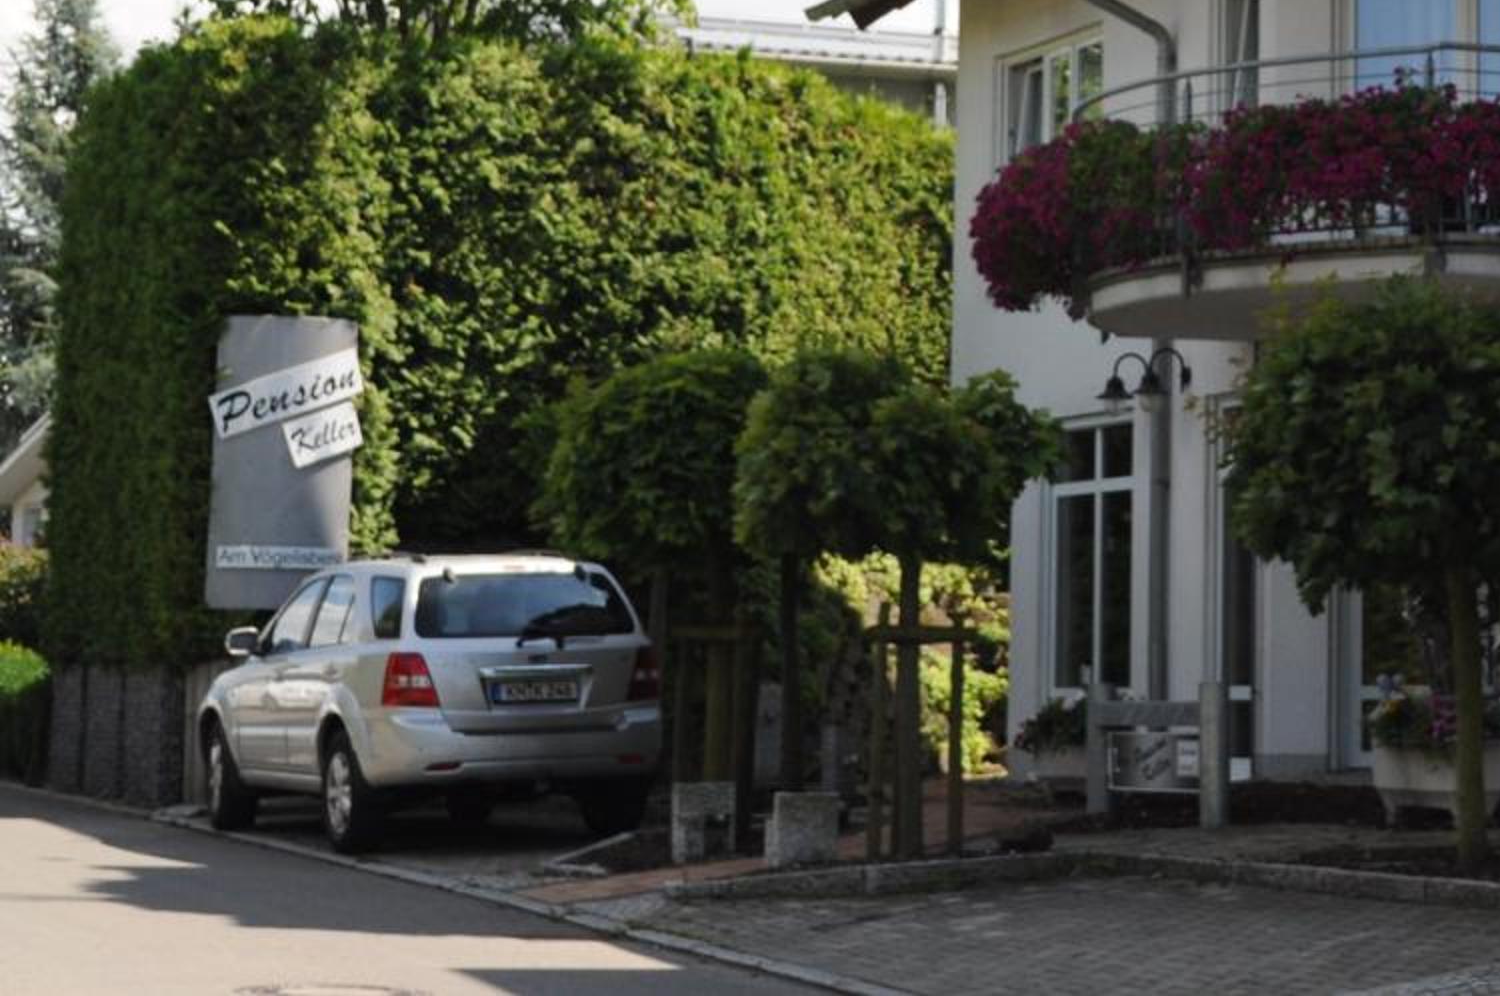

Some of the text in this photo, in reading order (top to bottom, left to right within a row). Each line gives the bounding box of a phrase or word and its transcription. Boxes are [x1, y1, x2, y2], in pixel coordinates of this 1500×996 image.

[216, 368, 355, 433] Pension
[290, 418, 356, 453] Keller
[219, 549, 246, 565] Am
